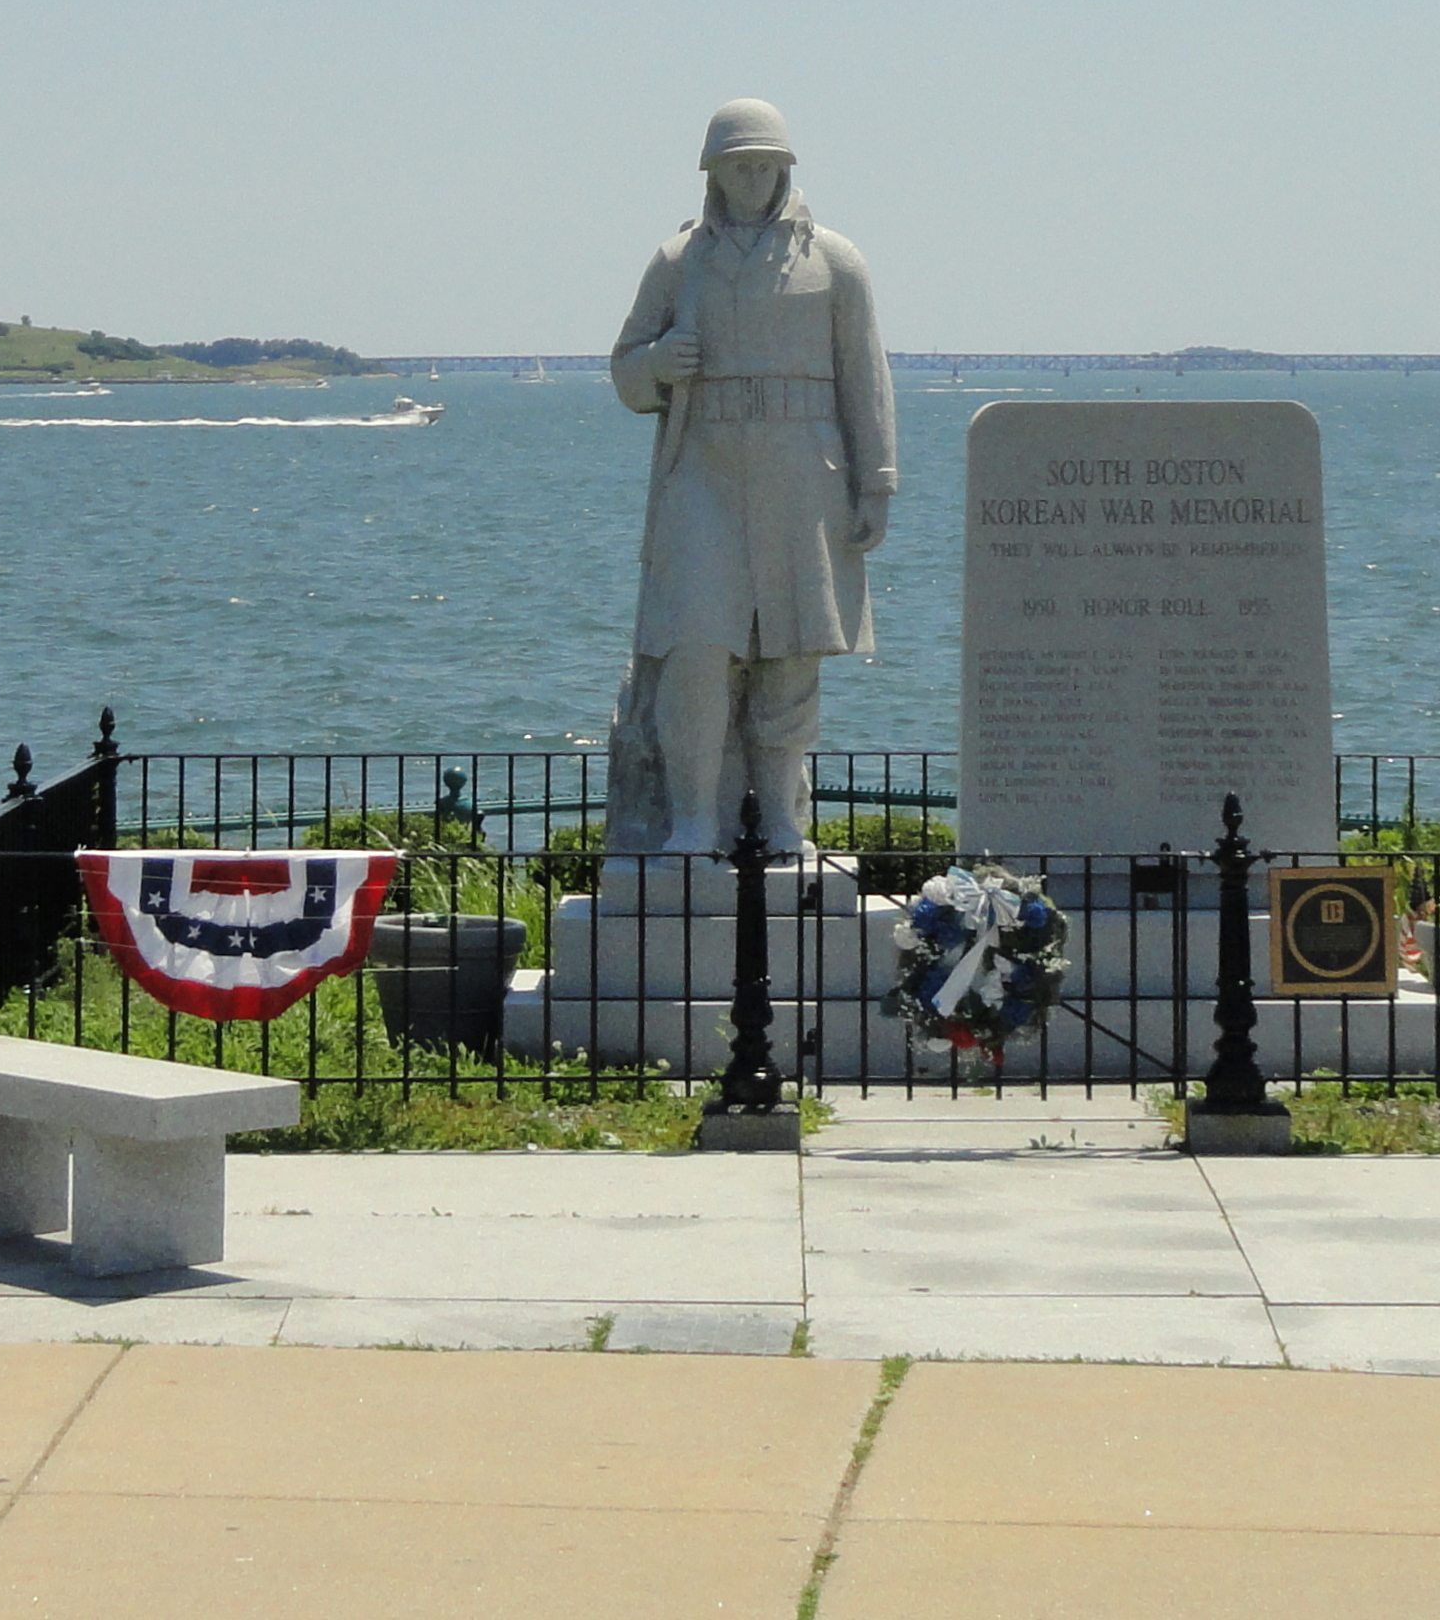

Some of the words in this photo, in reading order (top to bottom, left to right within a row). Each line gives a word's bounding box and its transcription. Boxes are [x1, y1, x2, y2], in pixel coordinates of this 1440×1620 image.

[1046, 459, 1131, 486] SOUTH
[1145, 459, 1245, 486] BOSTON
[980, 498, 1087, 525] KOREAN
[1100, 498, 1155, 525] WAR
[1170, 498, 1312, 525] MEMORIAL
[989, 542, 1032, 557] THEY
[1043, 542, 1083, 557] WILL
[1092, 542, 1154, 557] ALWAYS
[1162, 542, 1181, 557] BE
[1022, 597, 1057, 618] 1950
[1082, 597, 1150, 617] HONOR
[1161, 597, 1213, 617] ROLL
